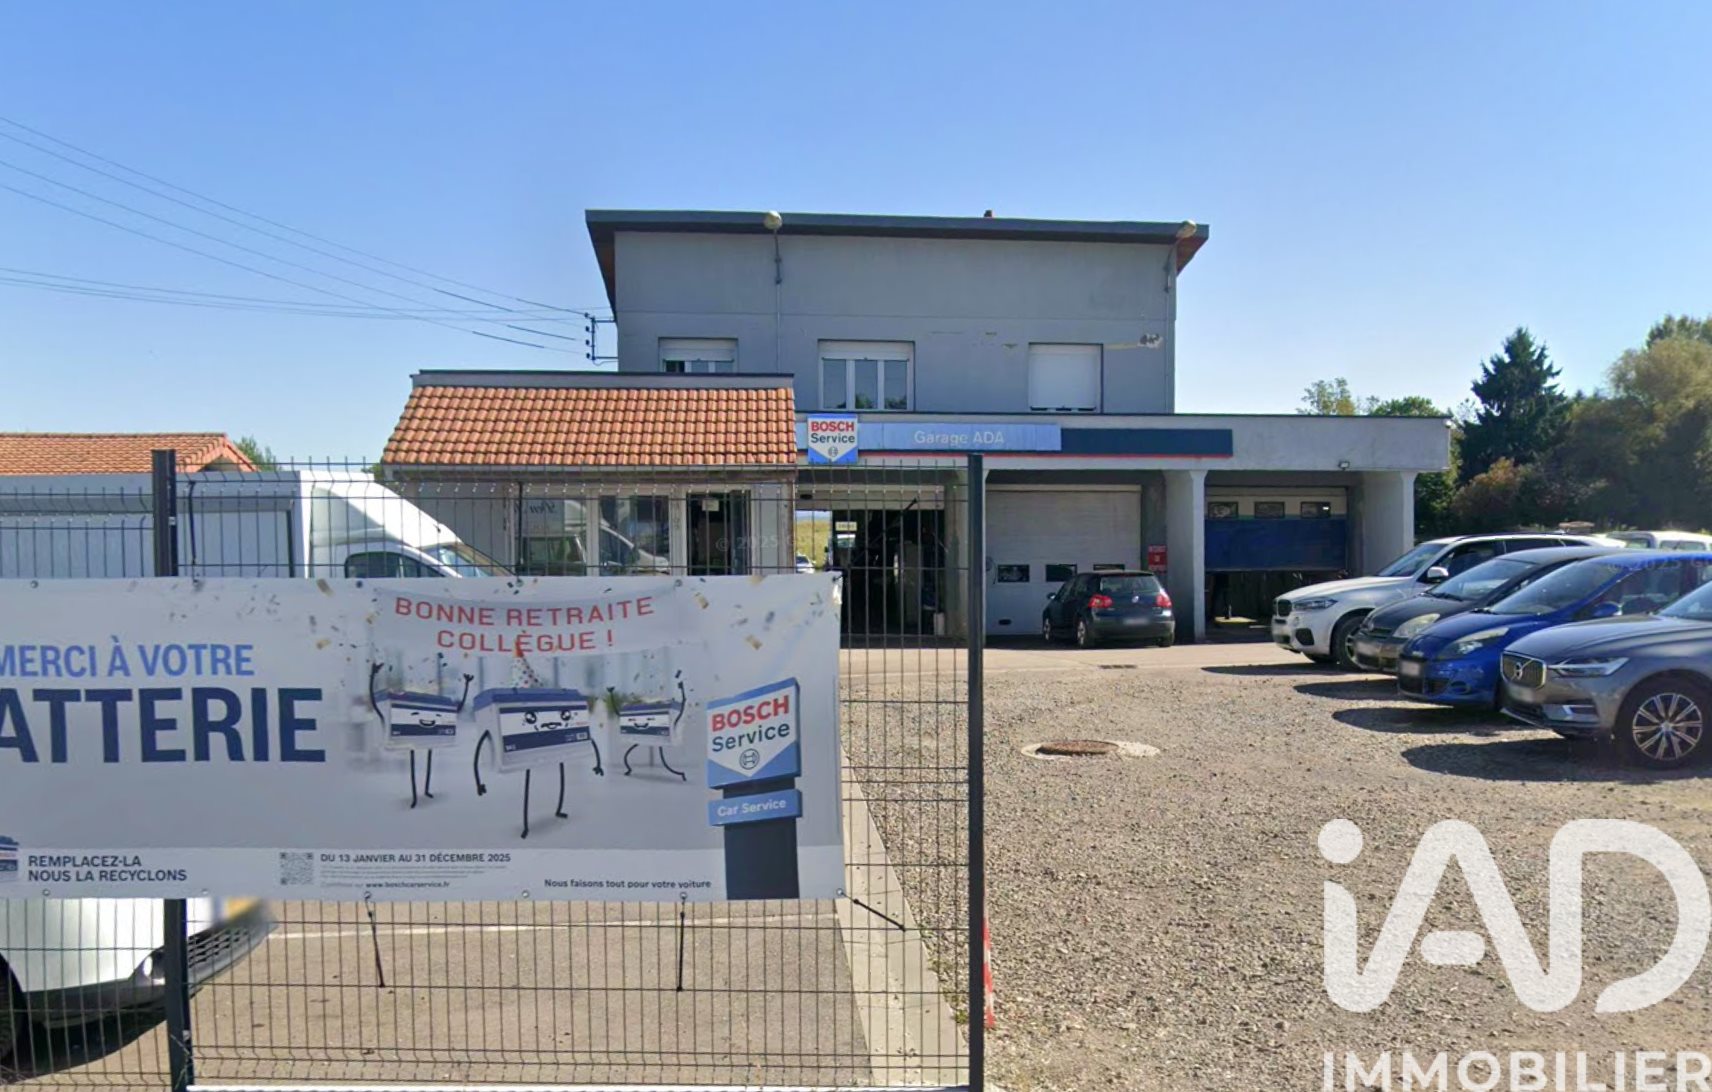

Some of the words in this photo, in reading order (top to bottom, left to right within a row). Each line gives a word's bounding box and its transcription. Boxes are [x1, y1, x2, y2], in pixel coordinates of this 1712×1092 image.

[810, 421, 855, 432] BOSCH
[810, 433, 855, 444] Service
[914, 431, 968, 446] Garage
[973, 431, 1004, 444] ADA
[395, 597, 494, 626] BONNE
[506, 596, 654, 626] RETRAITE
[437, 629, 595, 652] COLLÈGUE
[607, 629, 614, 647] !
[107, 635, 131, 677] À
[138, 644, 255, 676] VOTRE
[712, 694, 790, 732] BOSCH
[712, 723, 790, 752] Service
[717, 804, 738, 817] Car
[742, 799, 787, 814] Service
[28, 855, 142, 867] REMPLACEZ-LA
[320, 853, 335, 862] DU
[339, 853, 350, 862] 13
[353, 854, 395, 863] JANVIER
[398, 854, 411, 862] AU
[414, 854, 426, 863] 31
[429, 852, 485, 863] DÉCEMBRE
[487, 853, 511, 862] 2025
[28, 870, 72, 882] NOUS
[76, 870, 94, 882] LA
[100, 869, 187, 881] RECYCLONS
[544, 879, 568, 887] Nous
[570, 879, 604, 888] faisons
[606, 879, 625, 888] tout
[627, 881, 649, 889] pour
[678, 880, 712, 889] voiture
